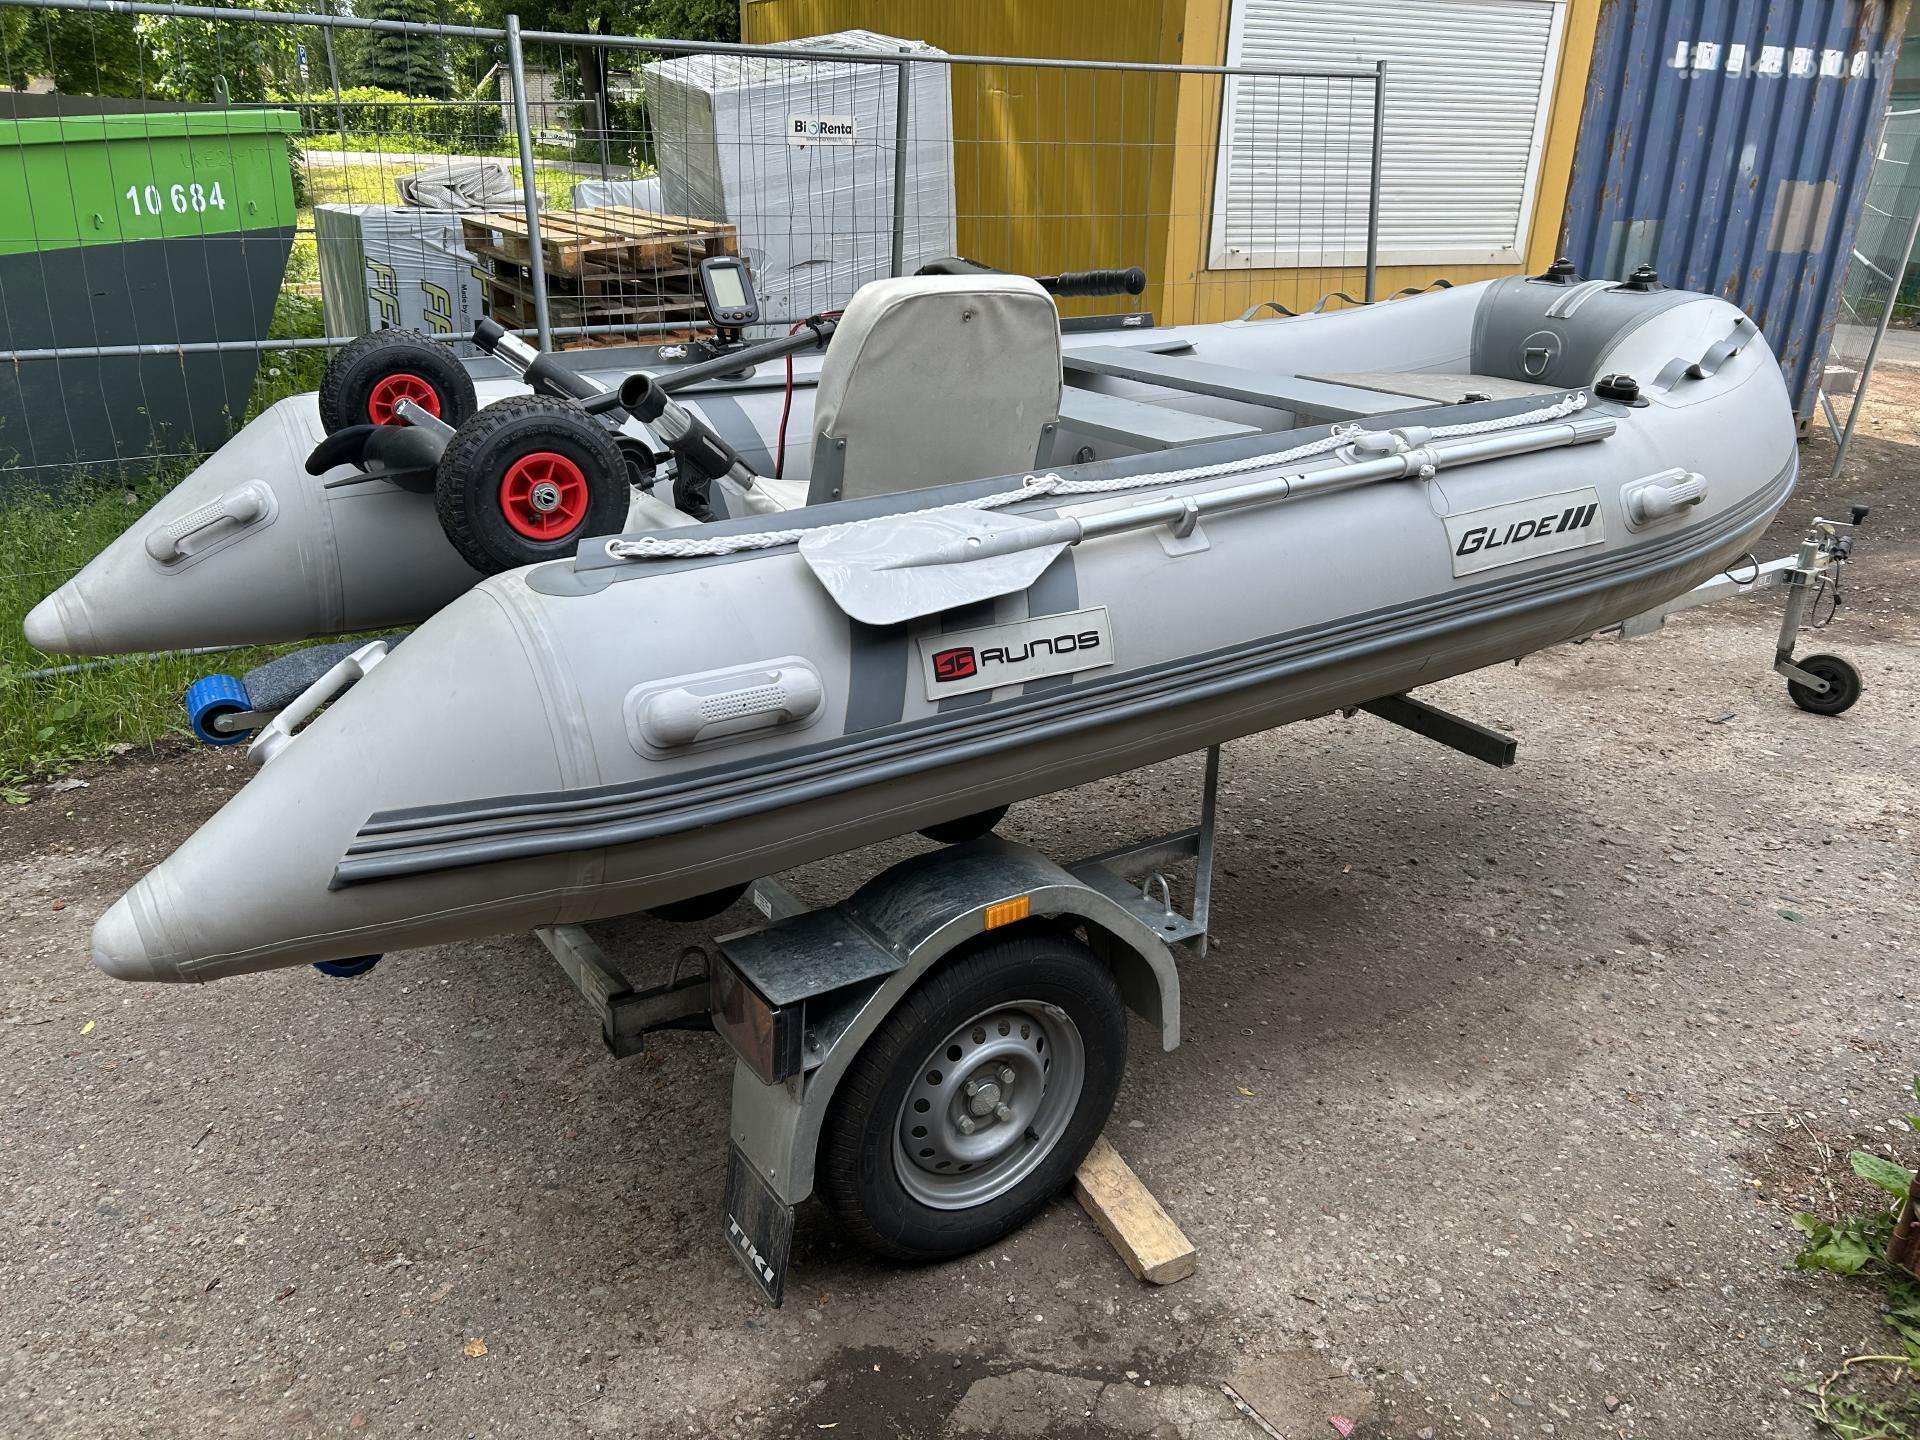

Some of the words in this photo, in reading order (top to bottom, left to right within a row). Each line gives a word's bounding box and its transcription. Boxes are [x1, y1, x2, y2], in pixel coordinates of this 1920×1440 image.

[126, 184, 162, 216] 10
[170, 181, 226, 214] 684
[980, 630, 1100, 667] RUNOS
[729, 1213, 775, 1283] TIKI
